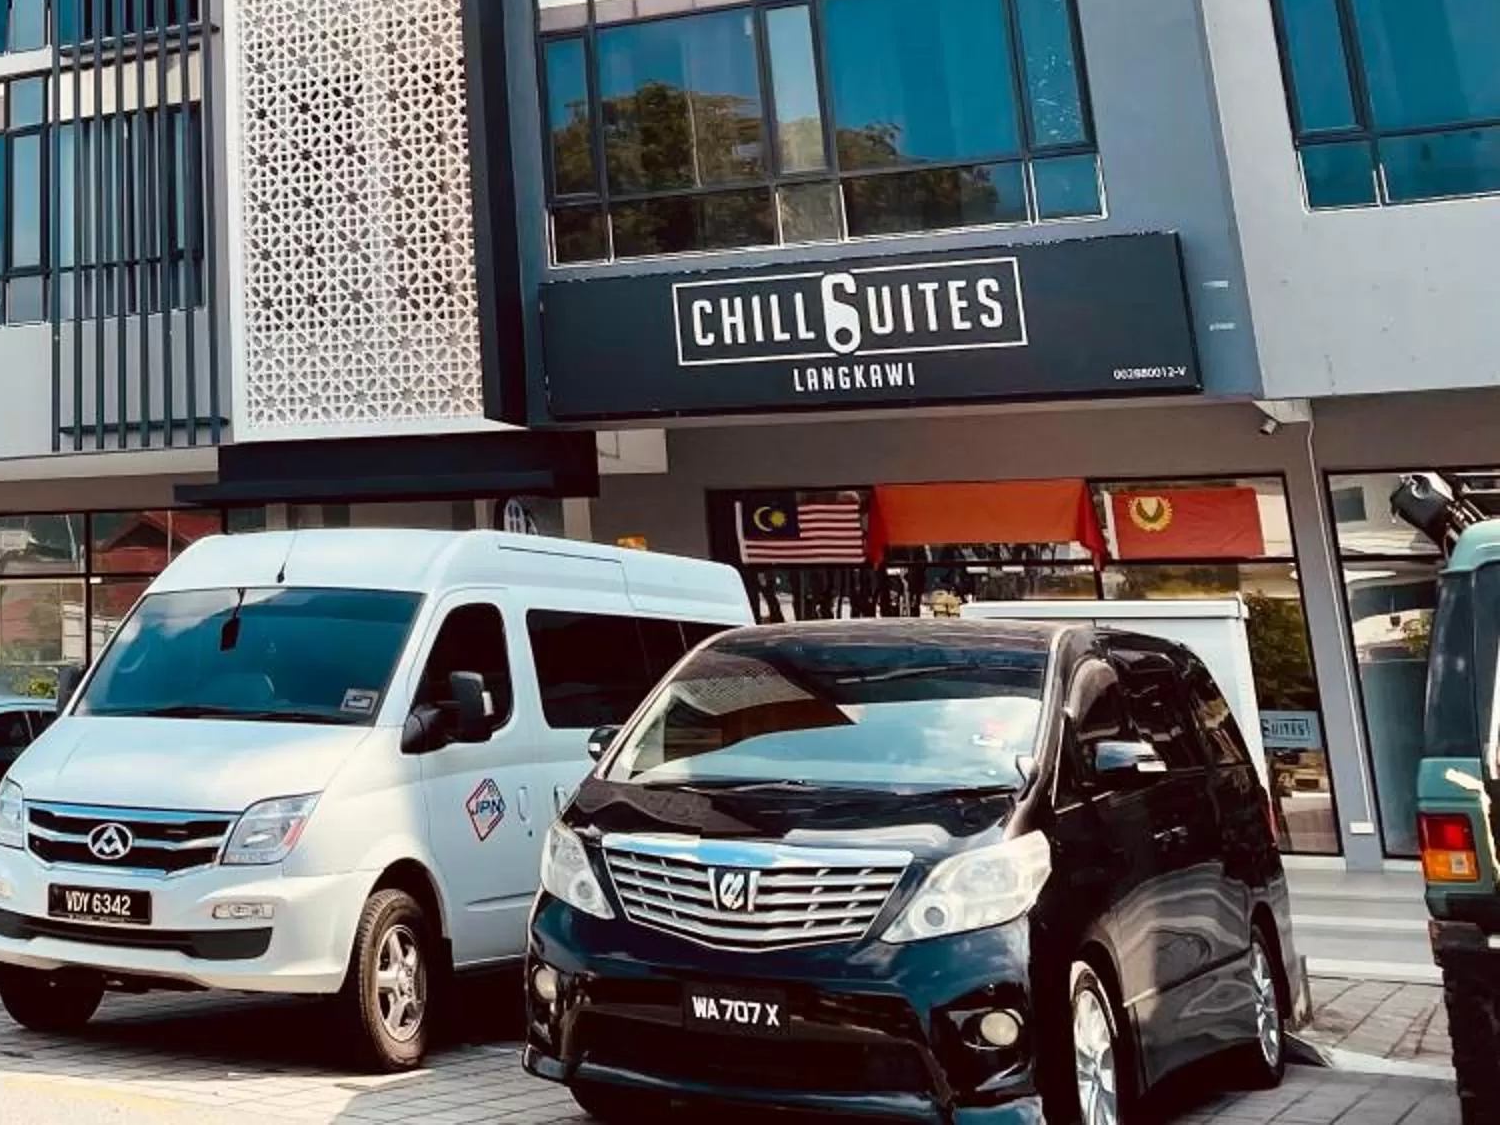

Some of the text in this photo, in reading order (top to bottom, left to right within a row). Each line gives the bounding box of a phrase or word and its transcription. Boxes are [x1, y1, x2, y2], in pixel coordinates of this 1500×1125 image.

[691, 292, 816, 346] CHILL
[793, 362, 916, 392] LANGKAWI
[65, 890, 131, 915] VDY 6342
[765, 1003, 780, 1027] X
